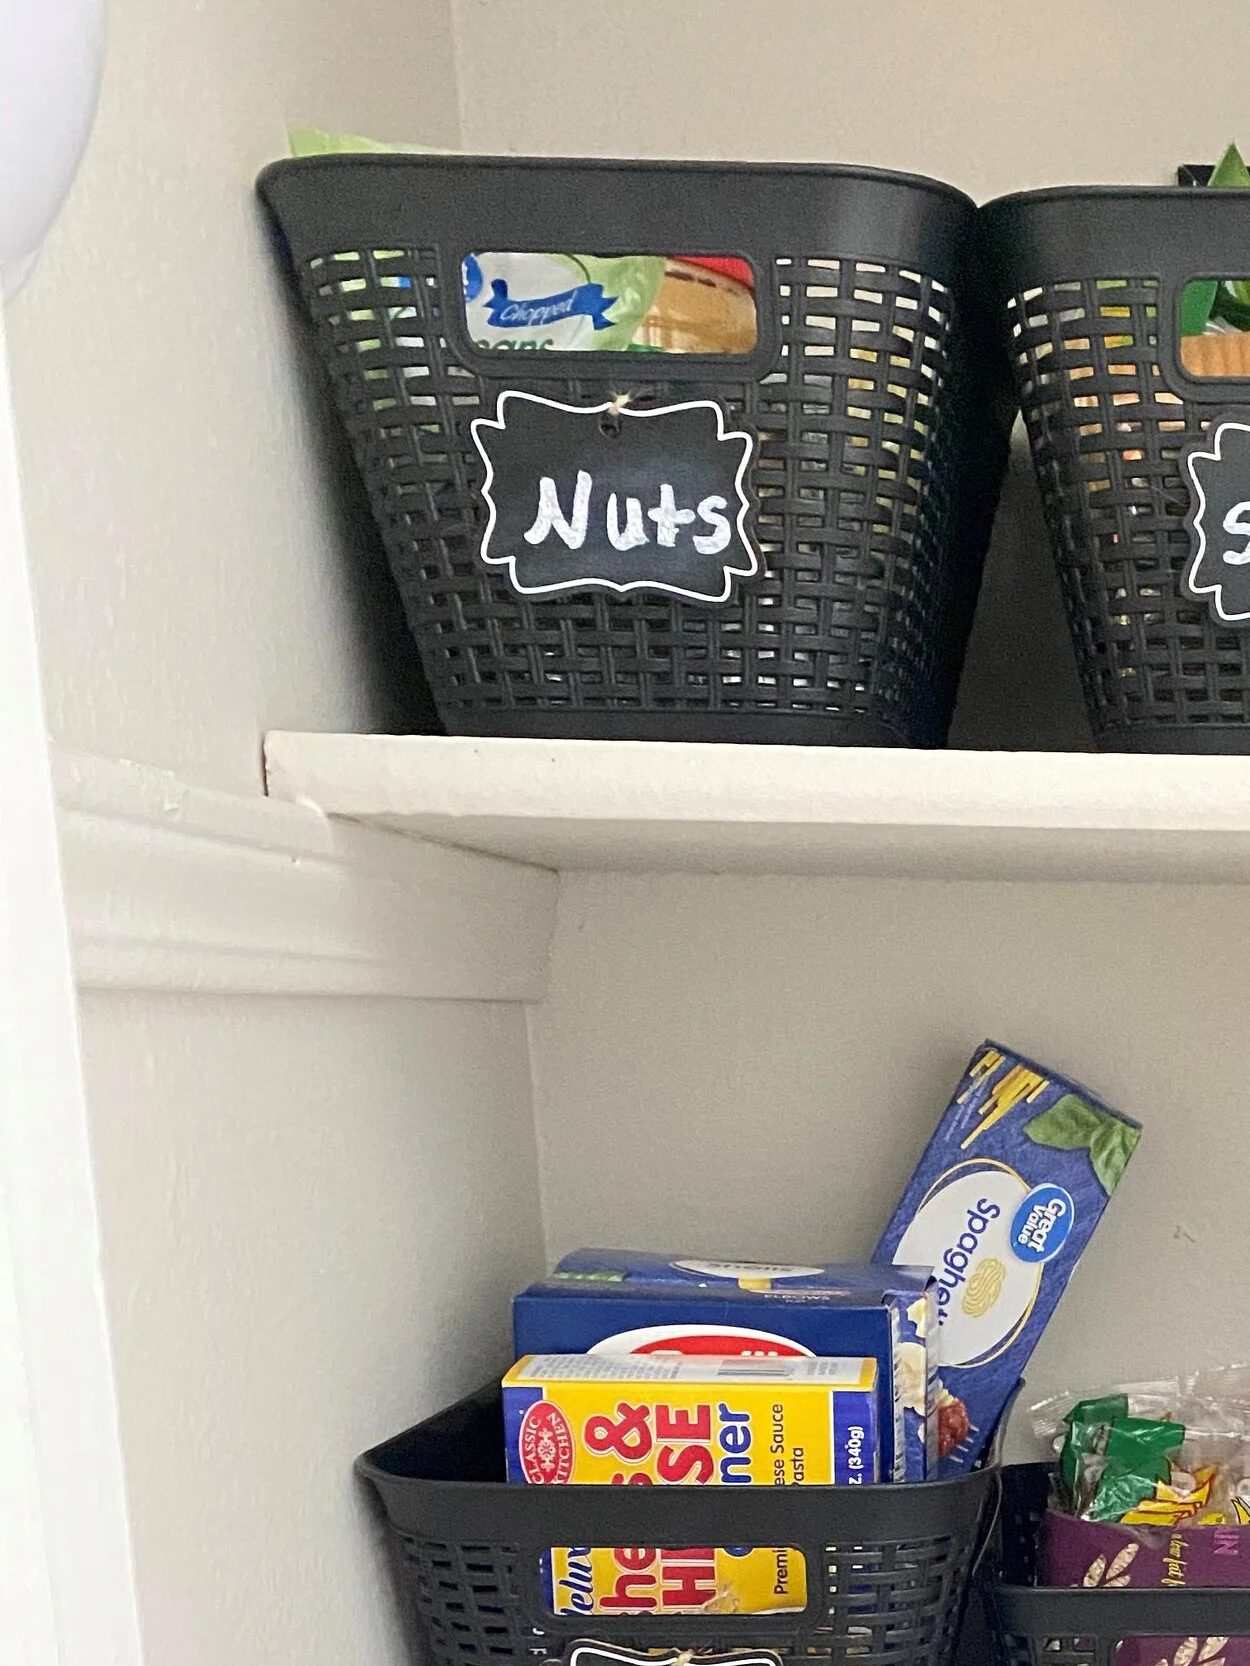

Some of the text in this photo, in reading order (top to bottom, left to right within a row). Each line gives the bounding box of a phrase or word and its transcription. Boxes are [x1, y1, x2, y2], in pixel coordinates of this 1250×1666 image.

[501, 289, 577, 325] Chopped
[524, 469, 731, 554] Nuts
[1018, 1203, 1047, 1244] Value
[1028, 1198, 1066, 1253] Great
[524, 1415, 545, 1485] CLASSIC
[584, 1401, 652, 1464] &
[770, 1404, 785, 1454] Sauce
[845, 1426, 865, 1469] (340g)
[1162, 1557, 1188, 1579] fat
[1169, 1540, 1190, 1557] low
